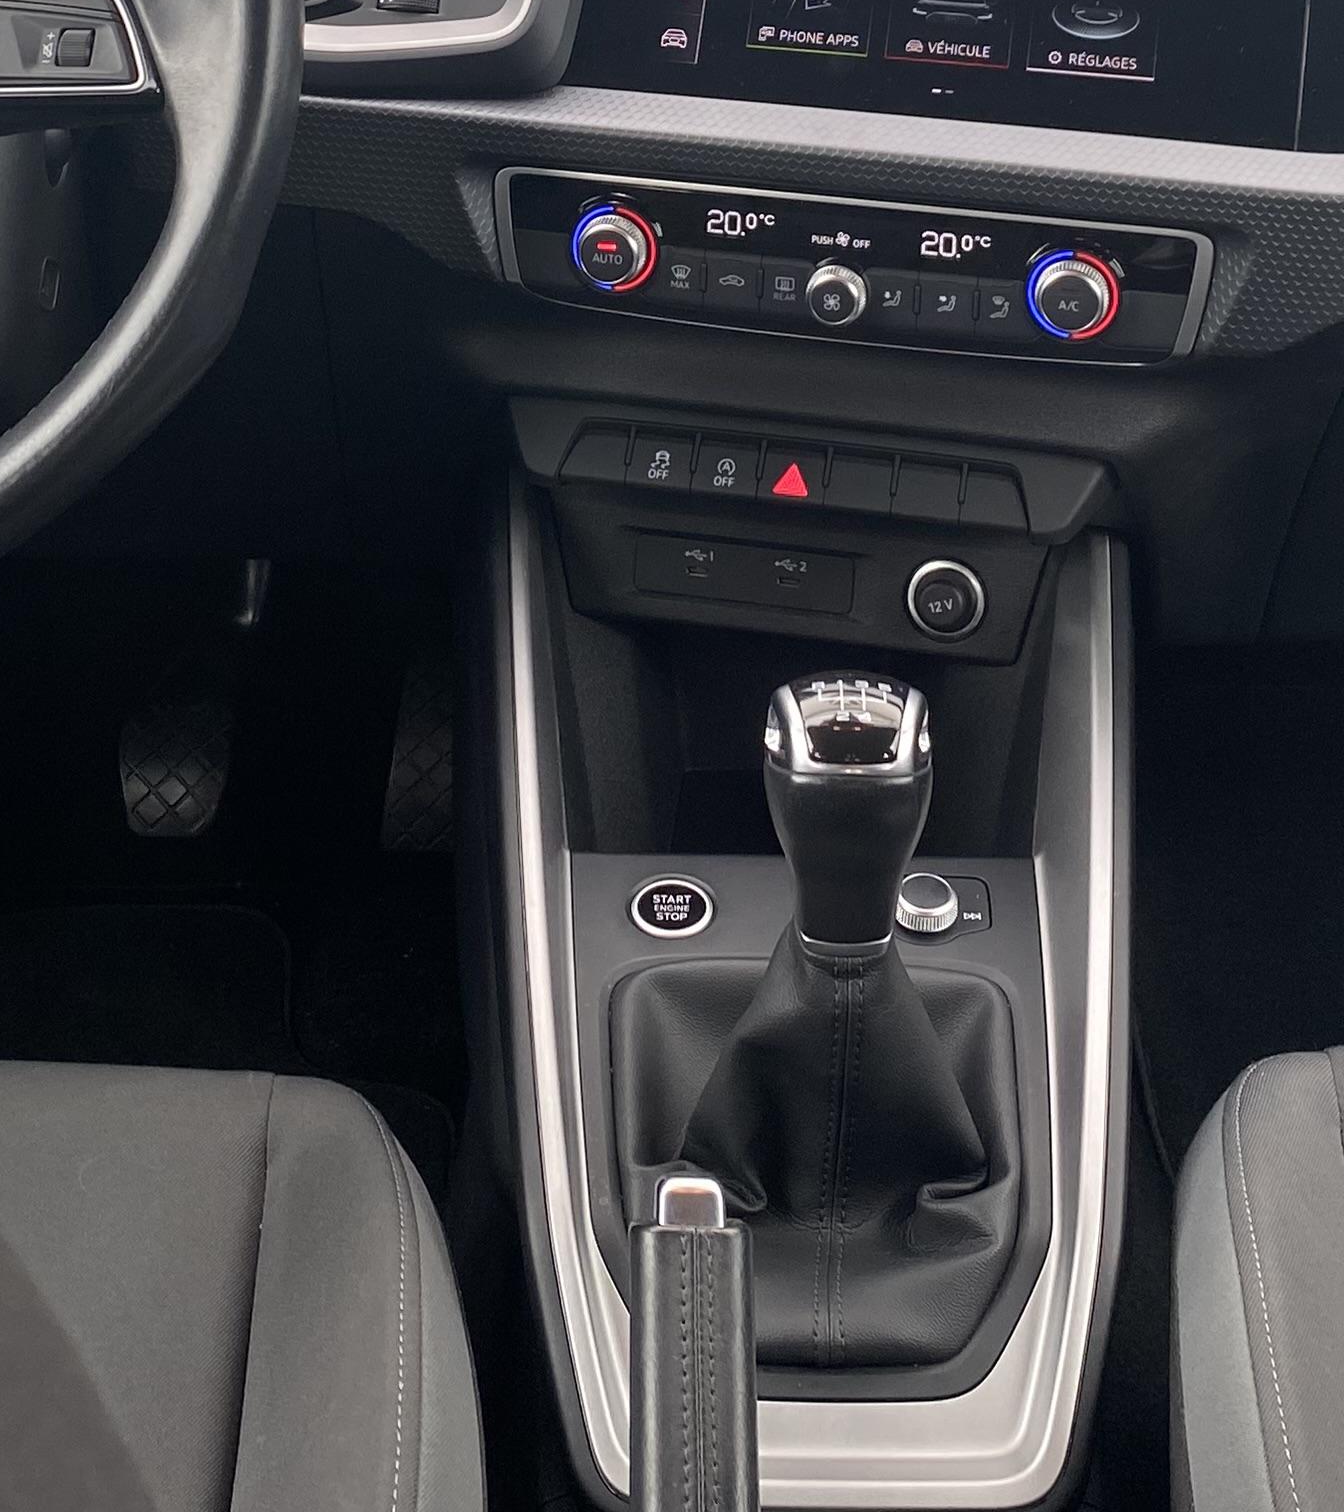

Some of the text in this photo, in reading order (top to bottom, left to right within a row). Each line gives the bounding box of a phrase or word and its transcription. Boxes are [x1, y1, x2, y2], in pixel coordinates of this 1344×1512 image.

[779, 29, 859, 48] PHONE APPS
[927, 39, 992, 59] VÉHICULE
[1068, 51, 1137, 71] RÉGLAGES
[811, 235, 871, 249] PUSH OFF
[592, 253, 623, 265] AUTO
[670, 280, 690, 289] MAX
[773, 292, 796, 302] REAR
[1058, 300, 1080, 312] A/C
[648, 469, 669, 480] OFF
[714, 476, 735, 487] OFF
[653, 894, 692, 904] START
[654, 904, 690, 912] ENGINE
[656, 912, 688, 921] STOP
